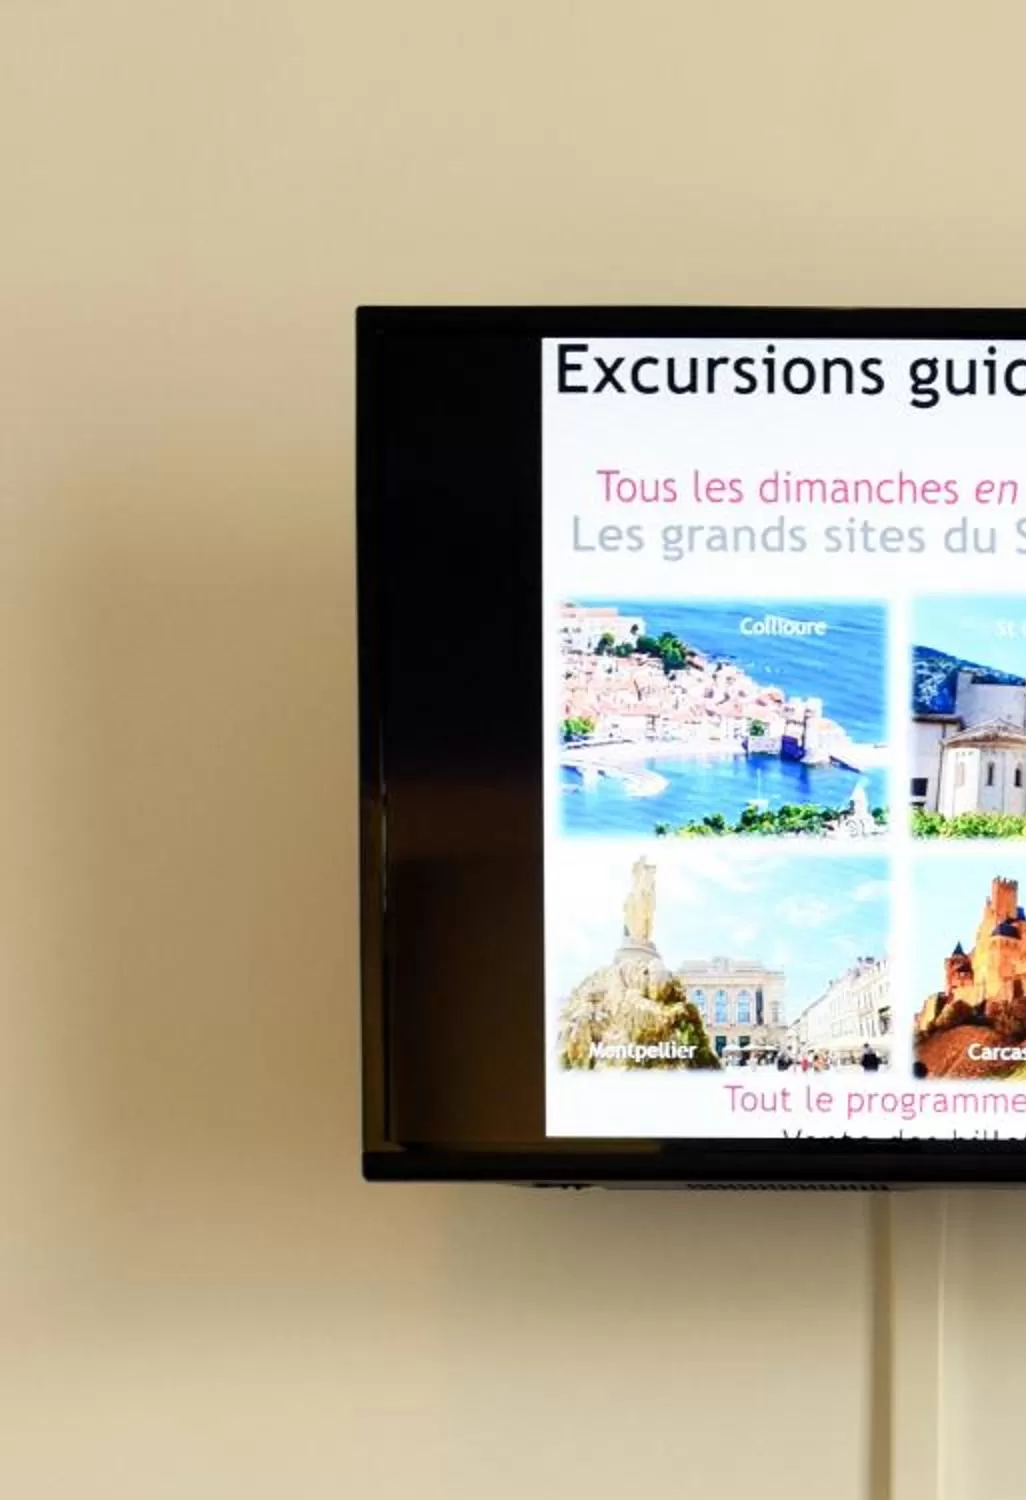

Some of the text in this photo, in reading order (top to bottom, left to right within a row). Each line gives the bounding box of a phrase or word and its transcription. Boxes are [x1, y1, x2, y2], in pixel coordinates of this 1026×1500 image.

[557, 343, 885, 395] Excursions
[597, 469, 678, 504] Tous
[693, 469, 744, 504] les
[758, 470, 959, 506] dimanches
[974, 478, 1018, 506] en
[572, 515, 644, 553] Les
[661, 515, 807, 561] grands
[824, 517, 925, 555] sites
[943, 516, 997, 555] du
[588, 1041, 698, 1062] Montpellier
[724, 1084, 791, 1113] Tout
[805, 1085, 833, 1113] le
